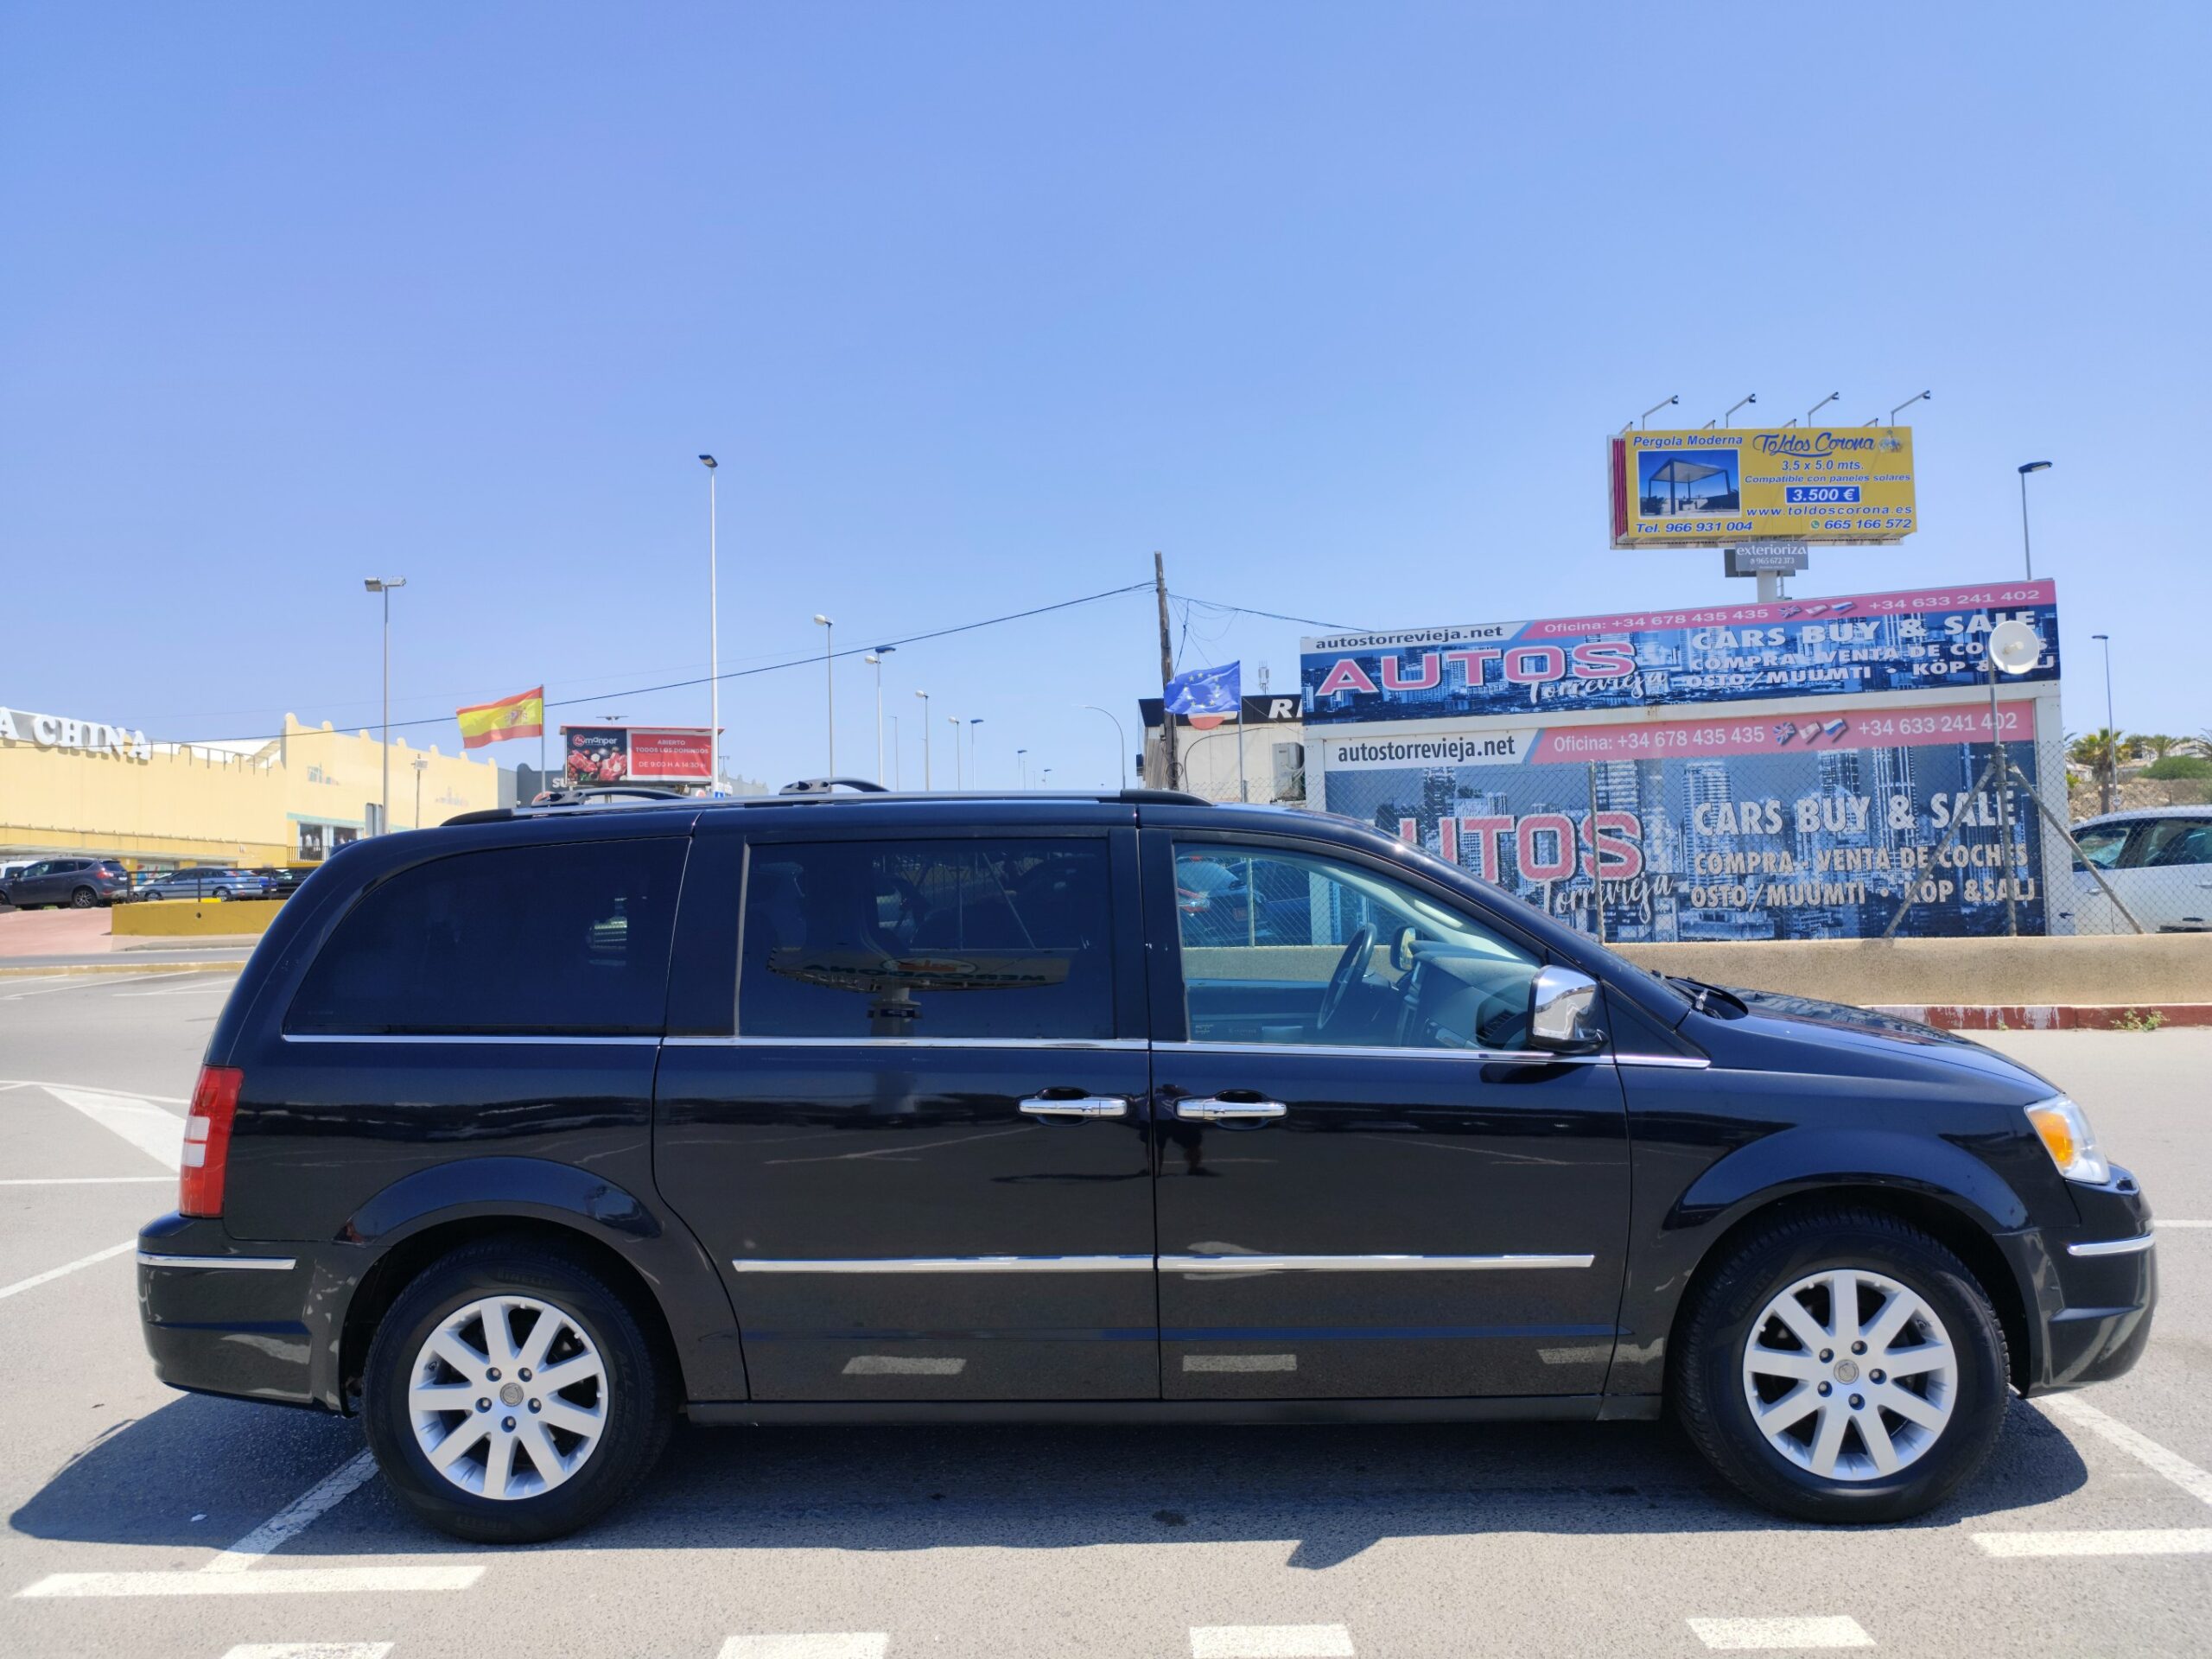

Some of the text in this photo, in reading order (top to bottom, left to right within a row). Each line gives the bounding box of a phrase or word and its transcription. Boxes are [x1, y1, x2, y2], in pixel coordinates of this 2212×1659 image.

[1633, 435, 1743, 448] Pérgola Moderna
[1752, 432, 1875, 457] Toldos Corona
[1837, 461, 1864, 470] mts.
[1745, 475, 1803, 484] Compatible
[1792, 487, 1855, 502] 3.500 €
[1745, 505, 1912, 517] www.toldoscorona.es
[1636, 521, 1753, 533] Tel. 966 931 004
[1824, 518, 1912, 530] 665 166 572
[1736, 543, 1807, 556] exterioriza
[1869, 590, 2040, 611] +34 633 241 402
[1544, 609, 1769, 633] Oficina: +34 678 435 435
[1315, 626, 1503, 649] autostorrevieja.net
[1692, 627, 1787, 652] CARS
[1802, 620, 1882, 645] BUY
[1898, 618, 1928, 639] &
[1691, 638, 2048, 671] COMPRA VENTA DE COS
[1315, 642, 1637, 696] AUTOS
[1912, 659, 1966, 676] KÖP
[1521, 671, 1669, 704] Torrevieja
[1859, 712, 2018, 737] +34 633 241 402
[33, 714, 151, 760] CHINA
[584, 736, 619, 746] manper
[1338, 735, 1516, 763] autostorrevieja.net
[1554, 726, 1764, 753] Oficina: +34 678 435 435
[1694, 791, 2016, 836] CARS BUY & SALE
[1694, 850, 1795, 875] COMPRA
[1816, 848, 1891, 872] VENTA
[1900, 846, 1929, 869] DE
[1535, 871, 1675, 924] Torrevieja
